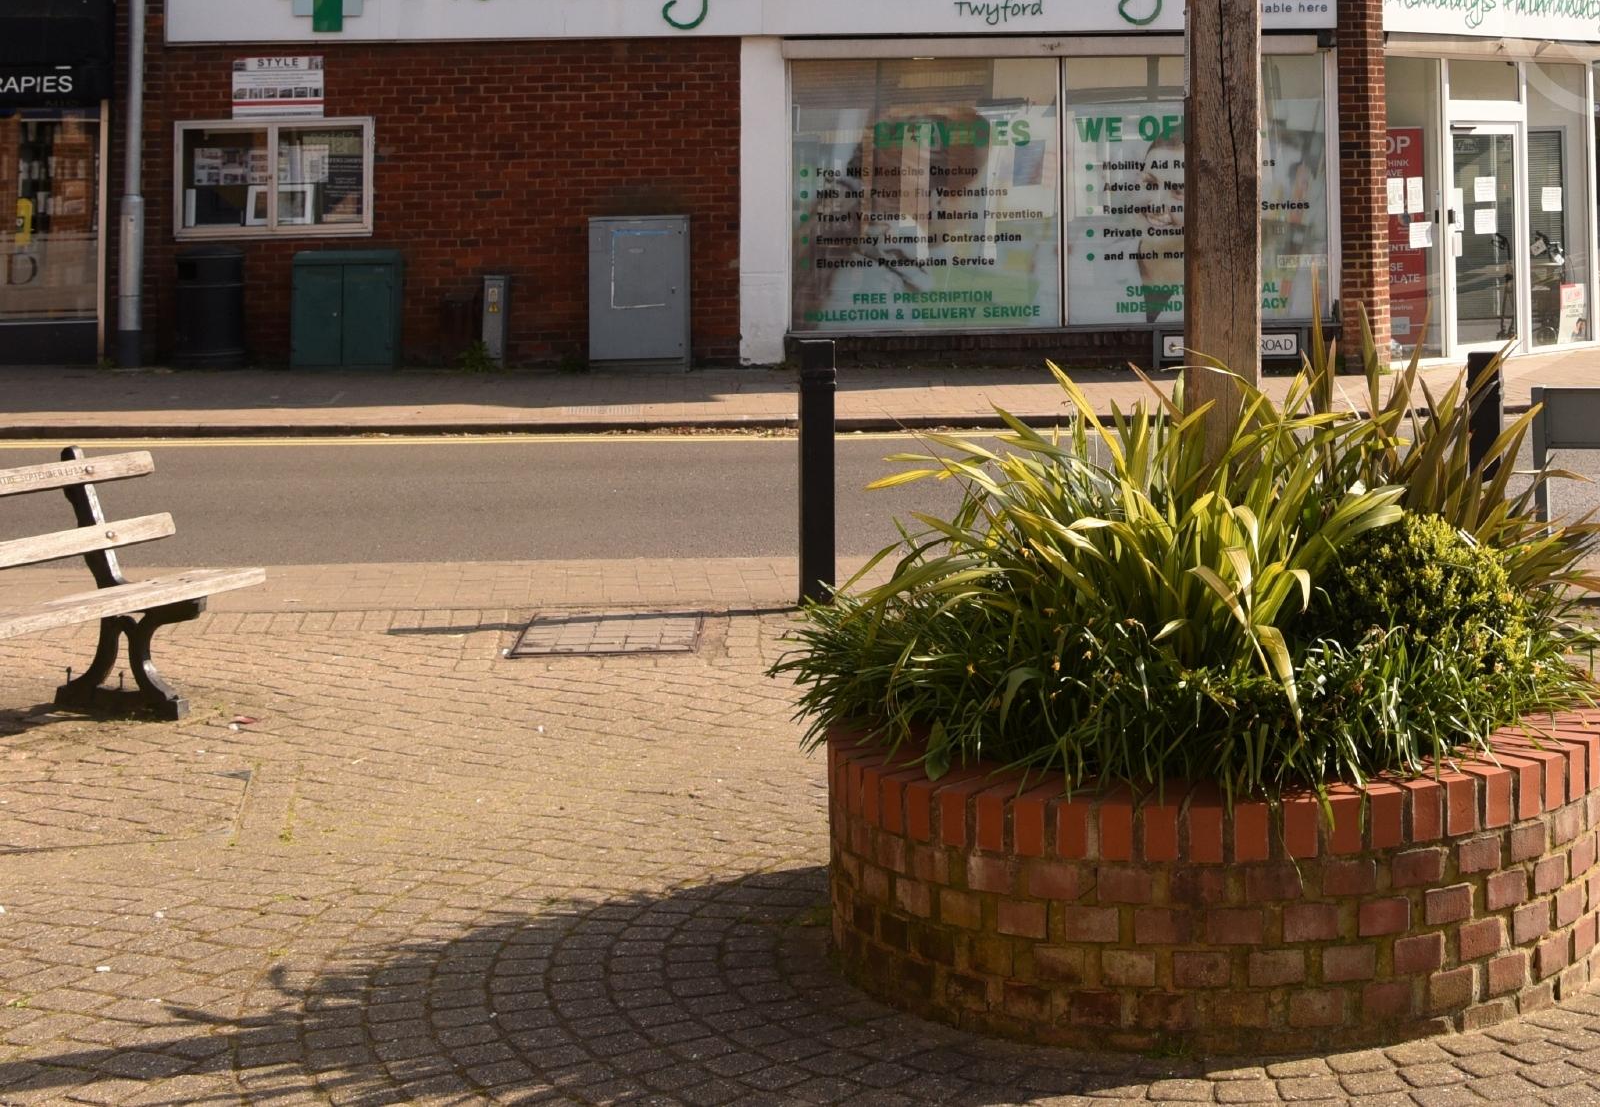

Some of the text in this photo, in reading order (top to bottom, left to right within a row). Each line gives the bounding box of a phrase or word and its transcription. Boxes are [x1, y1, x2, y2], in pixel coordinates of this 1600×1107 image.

[1260, 2, 1328, 13] lable here
[257, 57, 299, 67] STYLE
[0, 76, 73, 93] APIES
[1075, 116, 1122, 142] WE
[1102, 160, 1145, 172] Mobility
[1150, 160, 1168, 170] Aid
[1387, 159, 1409, 167] HINK
[816, 165, 978, 178] Free NHS Medicine Checkup
[816, 186, 1008, 199] NHS and Private Flu Vaccinations
[1103, 181, 1141, 192] Advice
[1145, 182, 1159, 191] on
[1103, 200, 1310, 215] Residential an Services
[817, 209, 1043, 222] Travel Vaccines and Malaria Prevention
[1103, 227, 1184, 238] Private Consul
[816, 233, 1022, 246] Emergency Hormonal Contraception
[816, 256, 995, 269] Electronic Prescription Service
[1104, 251, 1184, 261] and much mor
[853, 290, 993, 304] FREE PRESCRIPTION
[1116, 300, 1183, 313] INDEPEND
[804, 305, 1041, 322] COLLECTION & DELIVERY SERVICE
